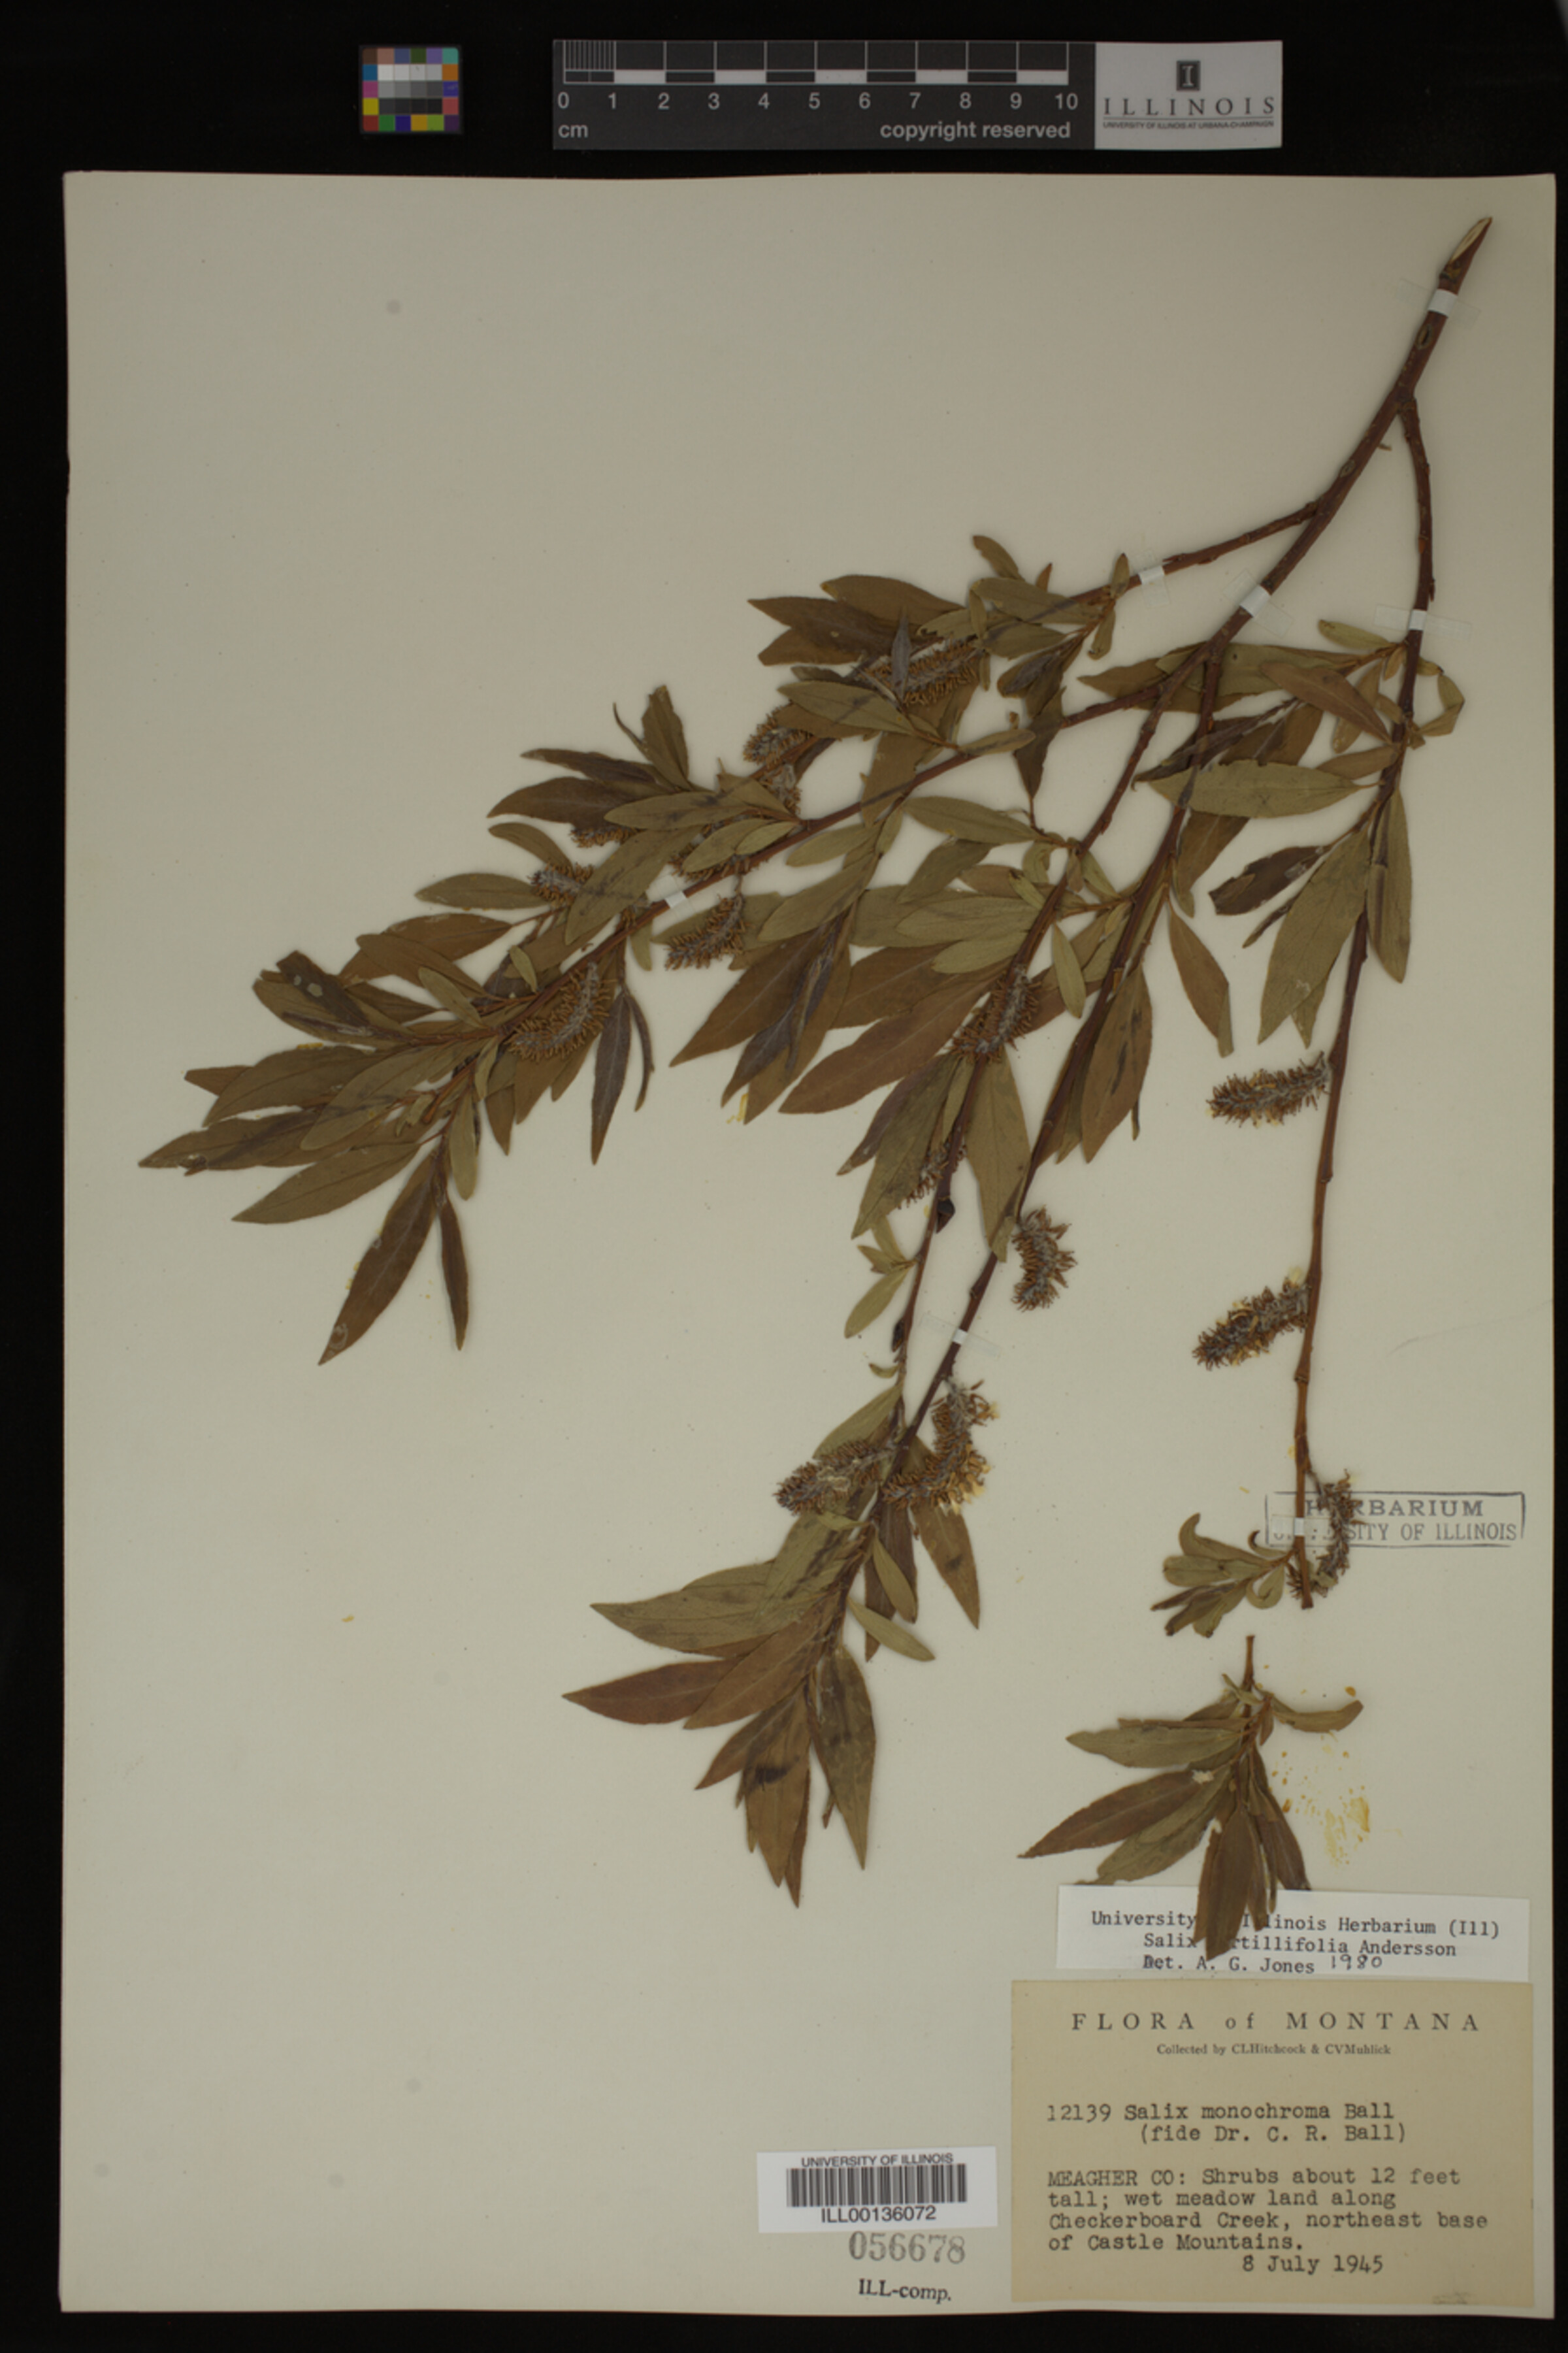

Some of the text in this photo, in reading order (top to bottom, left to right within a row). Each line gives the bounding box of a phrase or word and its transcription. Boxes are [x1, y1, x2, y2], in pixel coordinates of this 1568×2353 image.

[557, 91, 1079, 110] 0 1 2 3 4 5 6 7 8 9 10
[1104, 97, 1275, 116] ILLINOIS
[558, 124, 589, 139] cm
[880, 120, 1071, 142] copyright reserved
[1198, 120, 1274, 129] URBANA-CHAMPAIGN
[1305, 1499, 1484, 1517] HRBARIUM
[1400, 1522, 1425, 1541] OF
[1436, 1522, 1517, 1541] ILLINOIS
[1091, 1911, 1500, 1939] University Ilinois Herbarium (Ill)
[1143, 1932, 1458, 1956] Salix rtillifolia Andersson
[1143, 1954, 1316, 1973] Det. A. G. Jones
[1331, 1954, 1383, 1970] 1980
[1072, 2011, 1478, 2032] FLORA of MONTANA
[1156, 2043, 1391, 2056] Collected by CLHitchcock & CVMuhlick
[1047, 2101, 1394, 2124] 12139 Salix monochroma Ball
[1141, 2122, 1405, 2145] (fide Dr. C. R. Ball)
[801, 2153, 954, 2167] UNIVERSITY OF ILLINOIS
[1047, 2166, 1461, 2187] MEAGHER CO: Shrubs about 12 feet
[1048, 2188, 1396, 2211] tall; wet meadow land along
[821, 2205, 937, 2223] ILL00136072
[1049, 2211, 1488, 2231] Checkerboard Creek, northeast base
[848, 2231, 966, 2265] 056678
[1048, 2232, 1303, 2251] of Castle Mountains.
[1242, 2254, 1383, 2276] 8 July 1945
[858, 2278, 951, 2305] ILL-comp.
